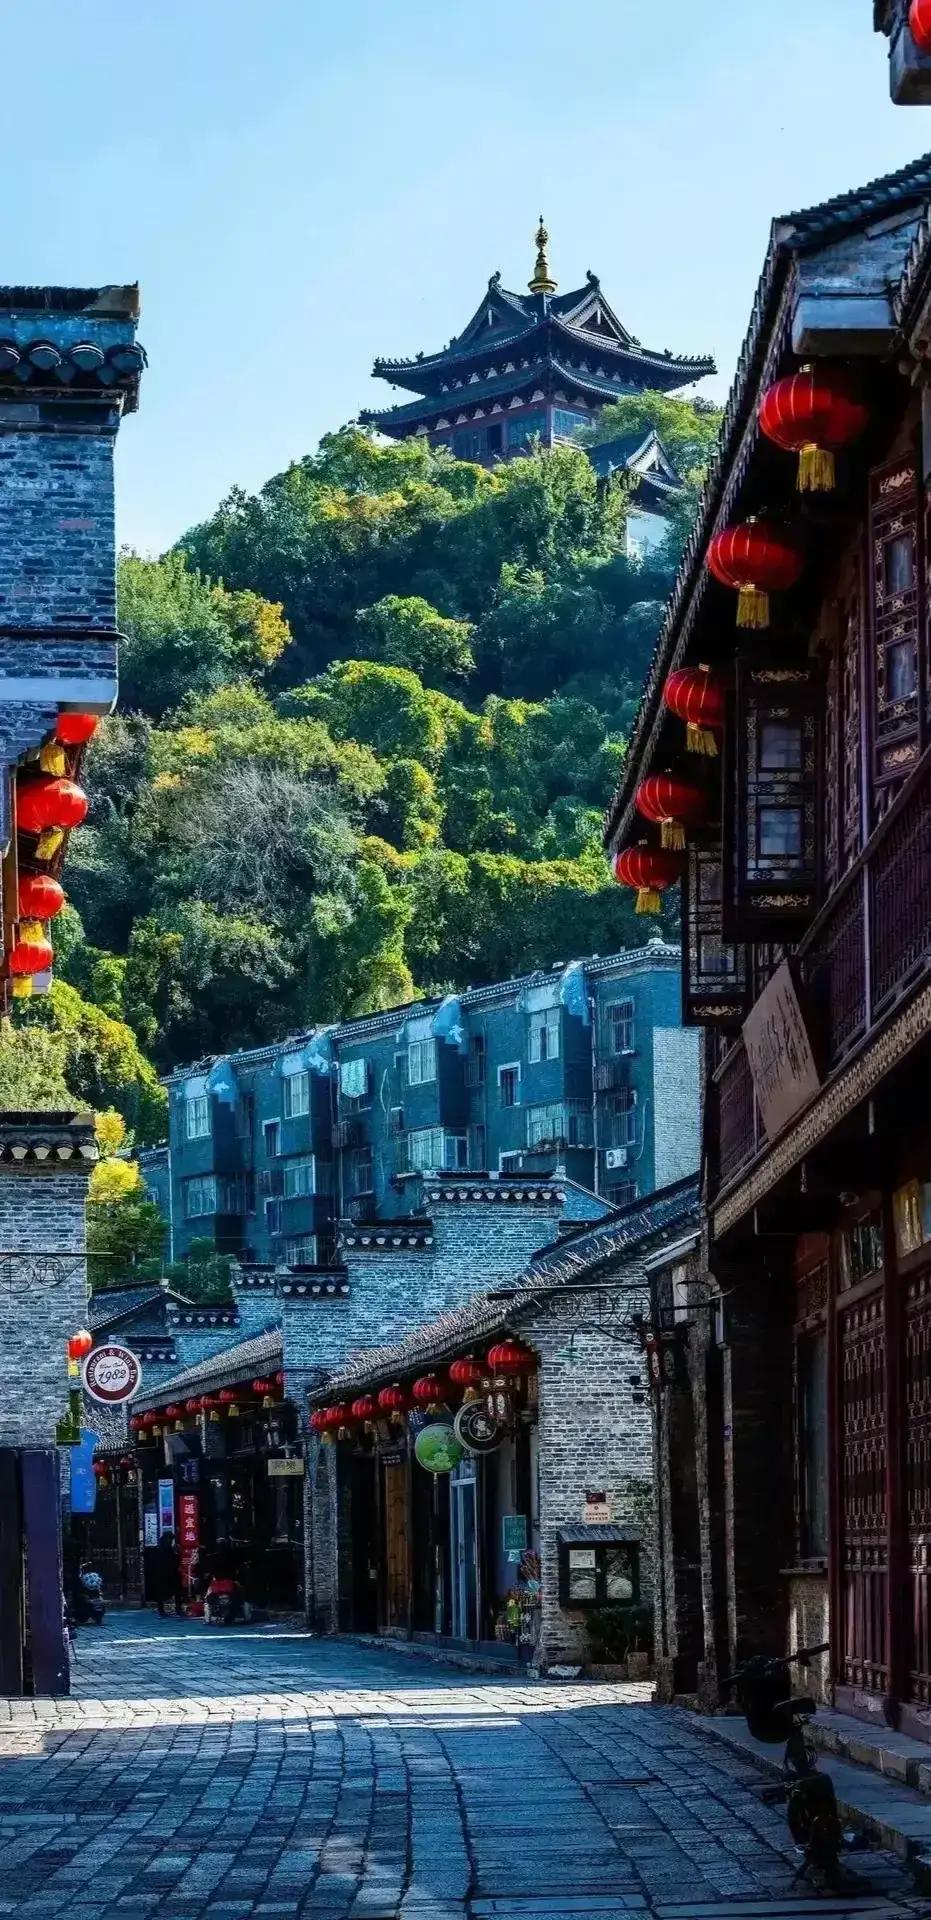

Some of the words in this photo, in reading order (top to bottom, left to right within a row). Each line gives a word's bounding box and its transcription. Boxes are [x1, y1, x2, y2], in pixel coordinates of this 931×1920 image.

[88, 1351, 107, 1388] Restaurant
[118, 1350, 133, 1367] Wine
[98, 1369, 127, 1385] 1982
